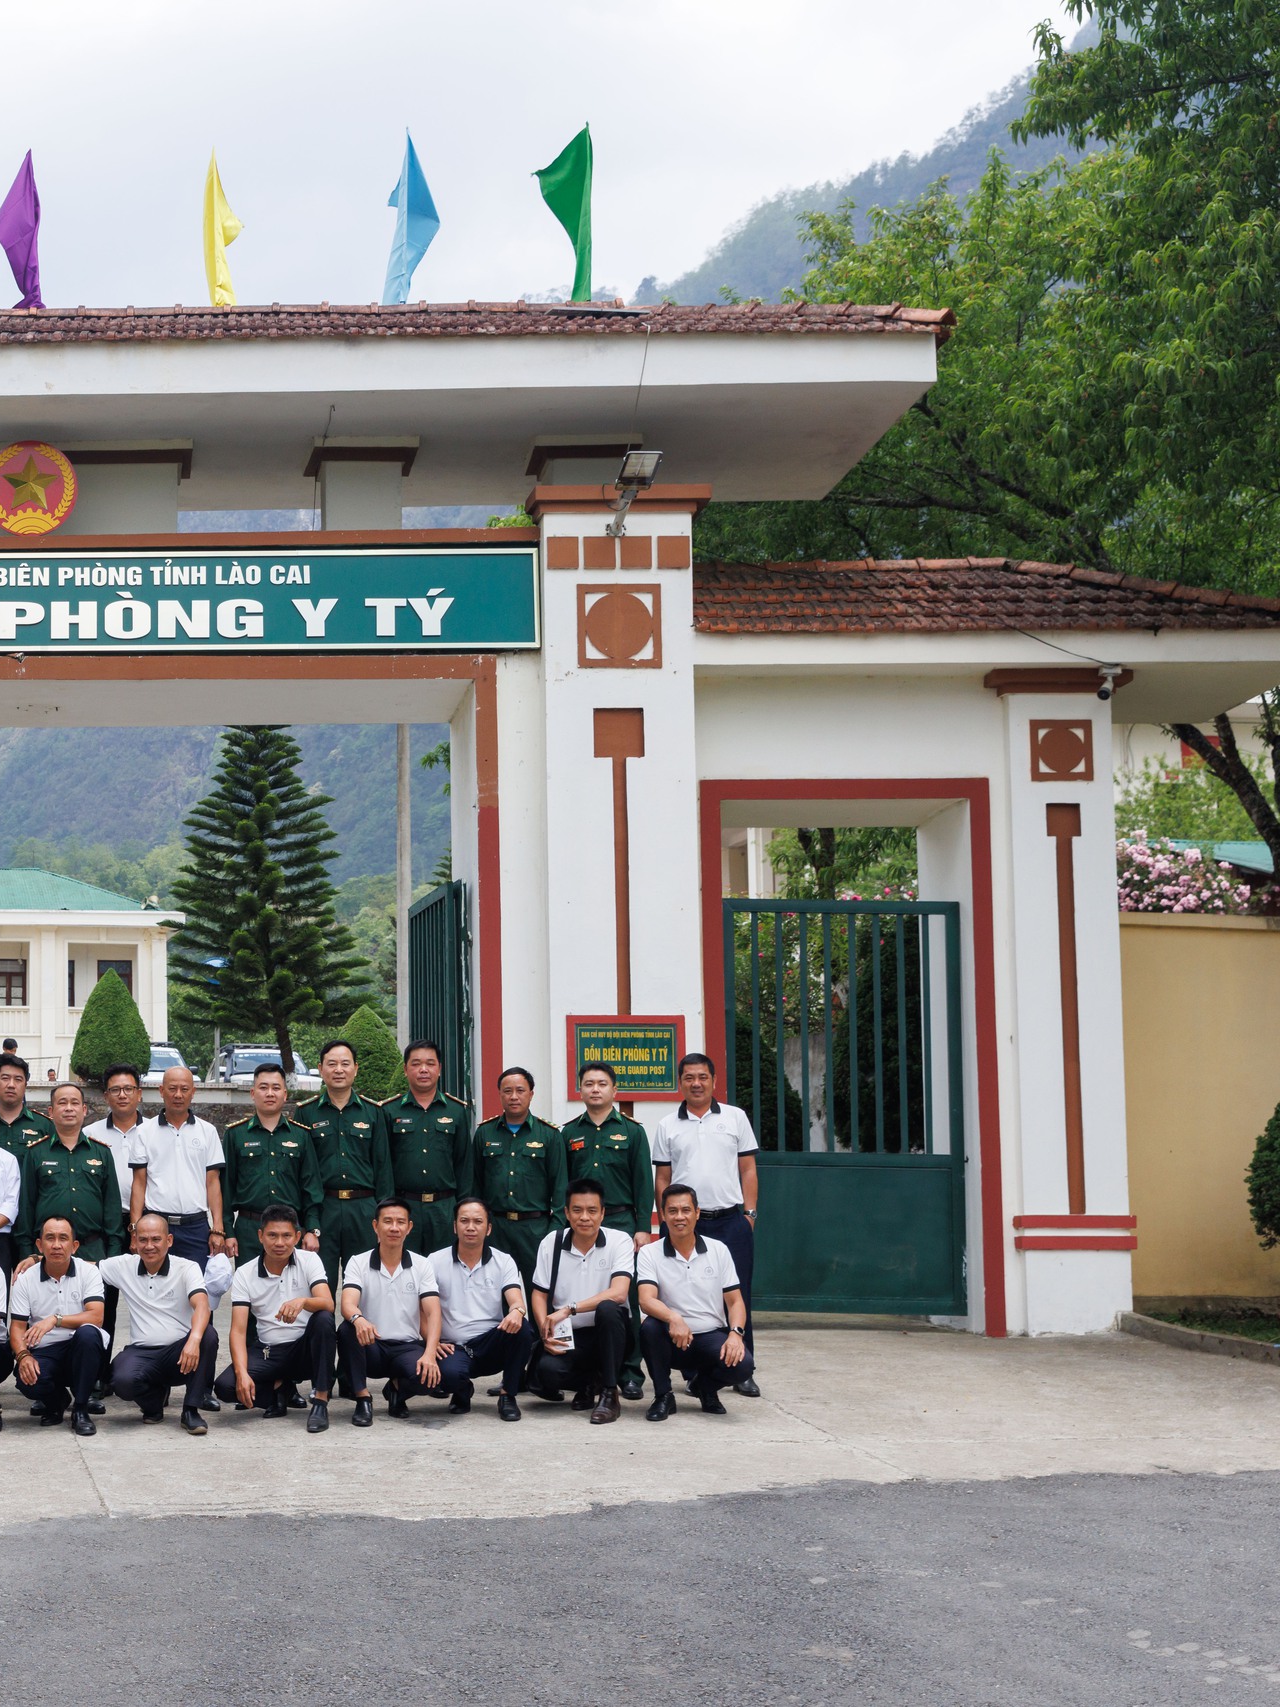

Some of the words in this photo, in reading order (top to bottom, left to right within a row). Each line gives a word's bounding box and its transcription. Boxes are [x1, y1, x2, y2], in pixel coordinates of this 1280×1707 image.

[57, 560, 143, 587] PHÒNG
[149, 558, 207, 587] TỈNH
[215, 560, 262, 586] LÀO
[269, 564, 311, 586] CAI
[291, 598, 339, 638] Y
[364, 587, 455, 637] TÝ
[584, 1043, 601, 1062] ĐỒN
[602, 1045, 621, 1062] BIÊN
[623, 1044, 650, 1062] PHÒNG
[651, 1048, 657, 1062] Y
[658, 1045, 668, 1062] TÝ
[627, 1065, 648, 1075] GUARD
[649, 1065, 666, 1075] POST
